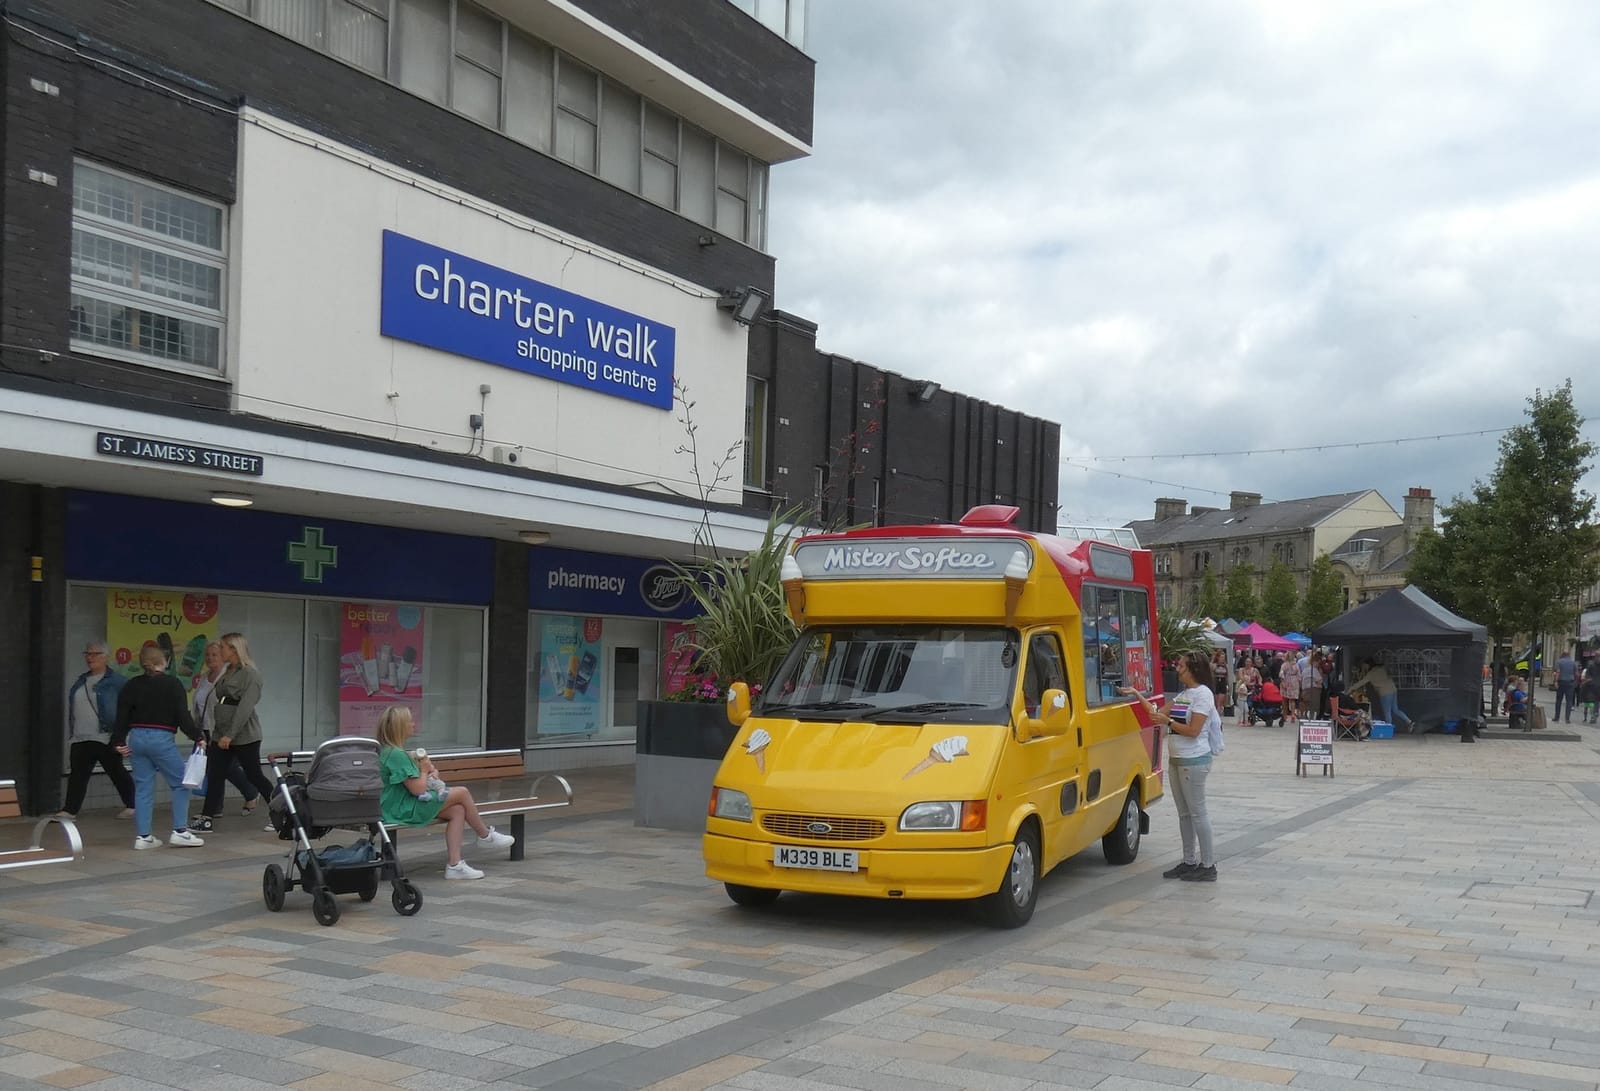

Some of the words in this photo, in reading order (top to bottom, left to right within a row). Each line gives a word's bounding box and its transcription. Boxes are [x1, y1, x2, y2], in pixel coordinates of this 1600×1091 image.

[415, 258, 575, 338] charter
[586, 317, 658, 367] walk
[517, 337, 597, 380] shopping
[603, 364, 657, 393] centre
[103, 436, 126, 453] ST.
[132, 441, 196, 463] JAMES'S
[203, 451, 258, 472] STREET
[823, 546, 900, 572] Mister
[899, 547, 994, 572] Softee
[548, 567, 626, 596] pharmacy
[114, 592, 171, 612] better
[347, 605, 390, 622] better
[131, 609, 183, 631] ready
[780, 848, 818, 866] M339
[823, 851, 853, 868] BLE
